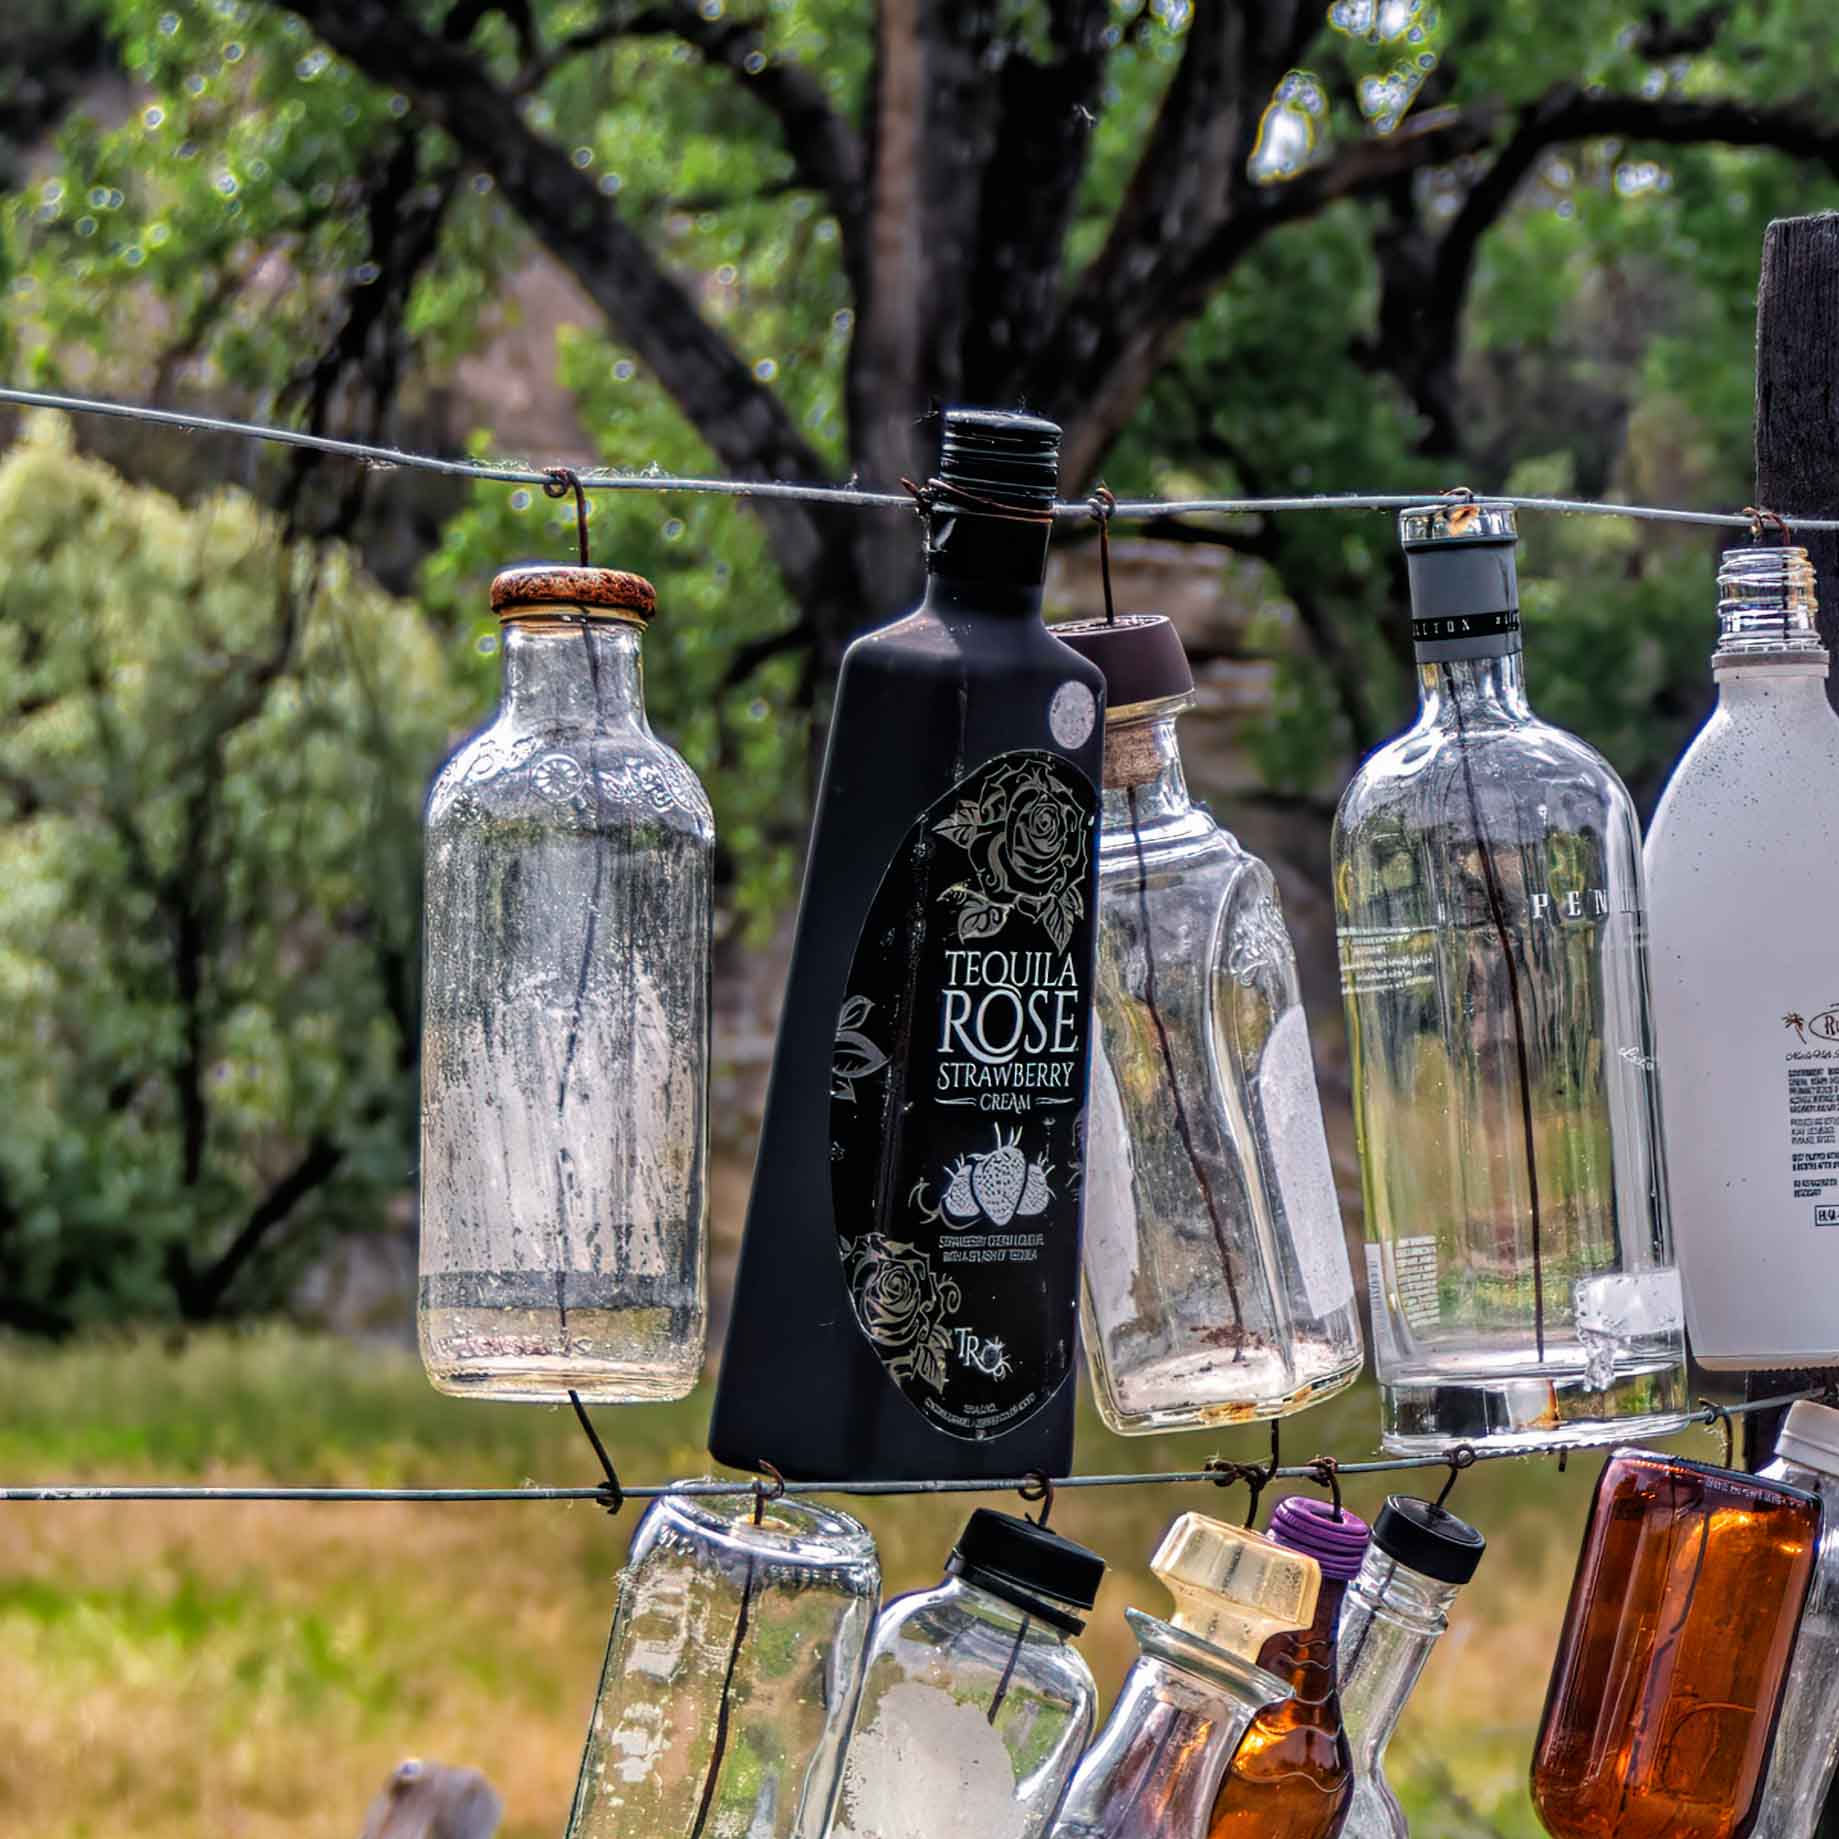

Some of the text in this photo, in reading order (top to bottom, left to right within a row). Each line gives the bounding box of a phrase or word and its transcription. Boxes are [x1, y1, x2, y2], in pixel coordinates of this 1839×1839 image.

[945, 950, 1079, 1000] TEQUILA
[937, 988, 1080, 1064] ROSE
[937, 1062, 1075, 1090] STRAWBERRY
[980, 1092, 1031, 1114] CREAM
